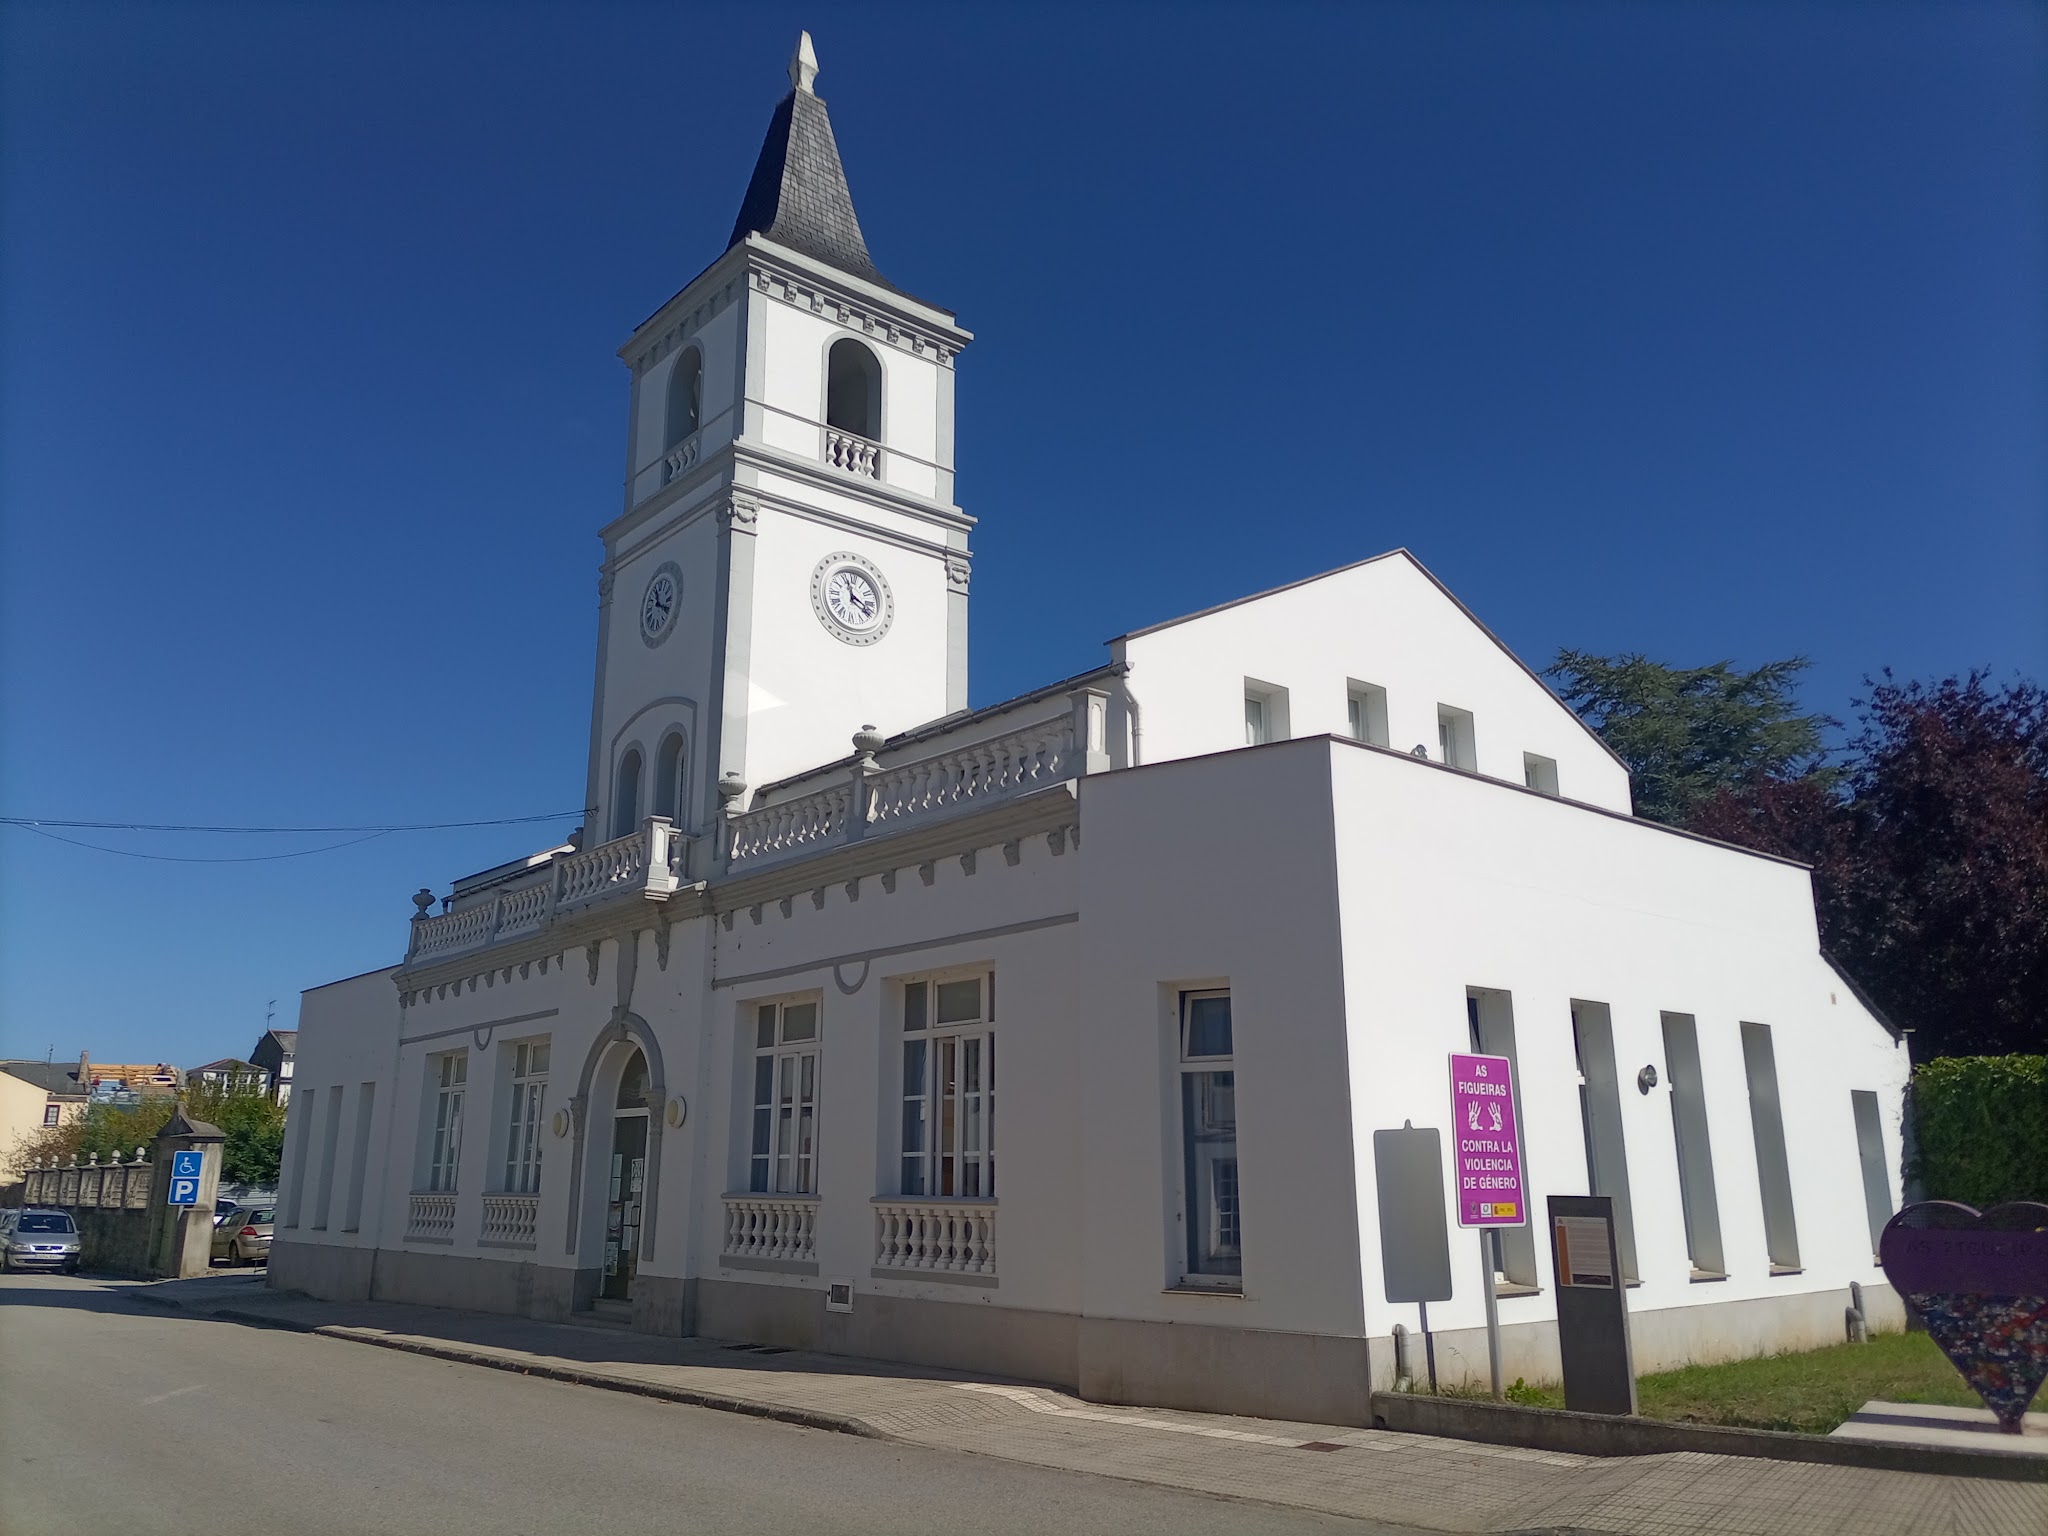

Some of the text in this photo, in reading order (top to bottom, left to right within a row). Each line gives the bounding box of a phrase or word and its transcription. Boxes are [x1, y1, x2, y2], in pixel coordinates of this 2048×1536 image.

[1475, 1064, 1488, 1078] AS
[1458, 1081, 1507, 1097] FIGUEIRAS
[1461, 1139, 1514, 1153] CONTRA LA
[1464, 1158, 1514, 1171] VIOLENCIA
[1463, 1173, 1517, 1190] DE GÉNERO
[174, 1180, 194, 1202] P
